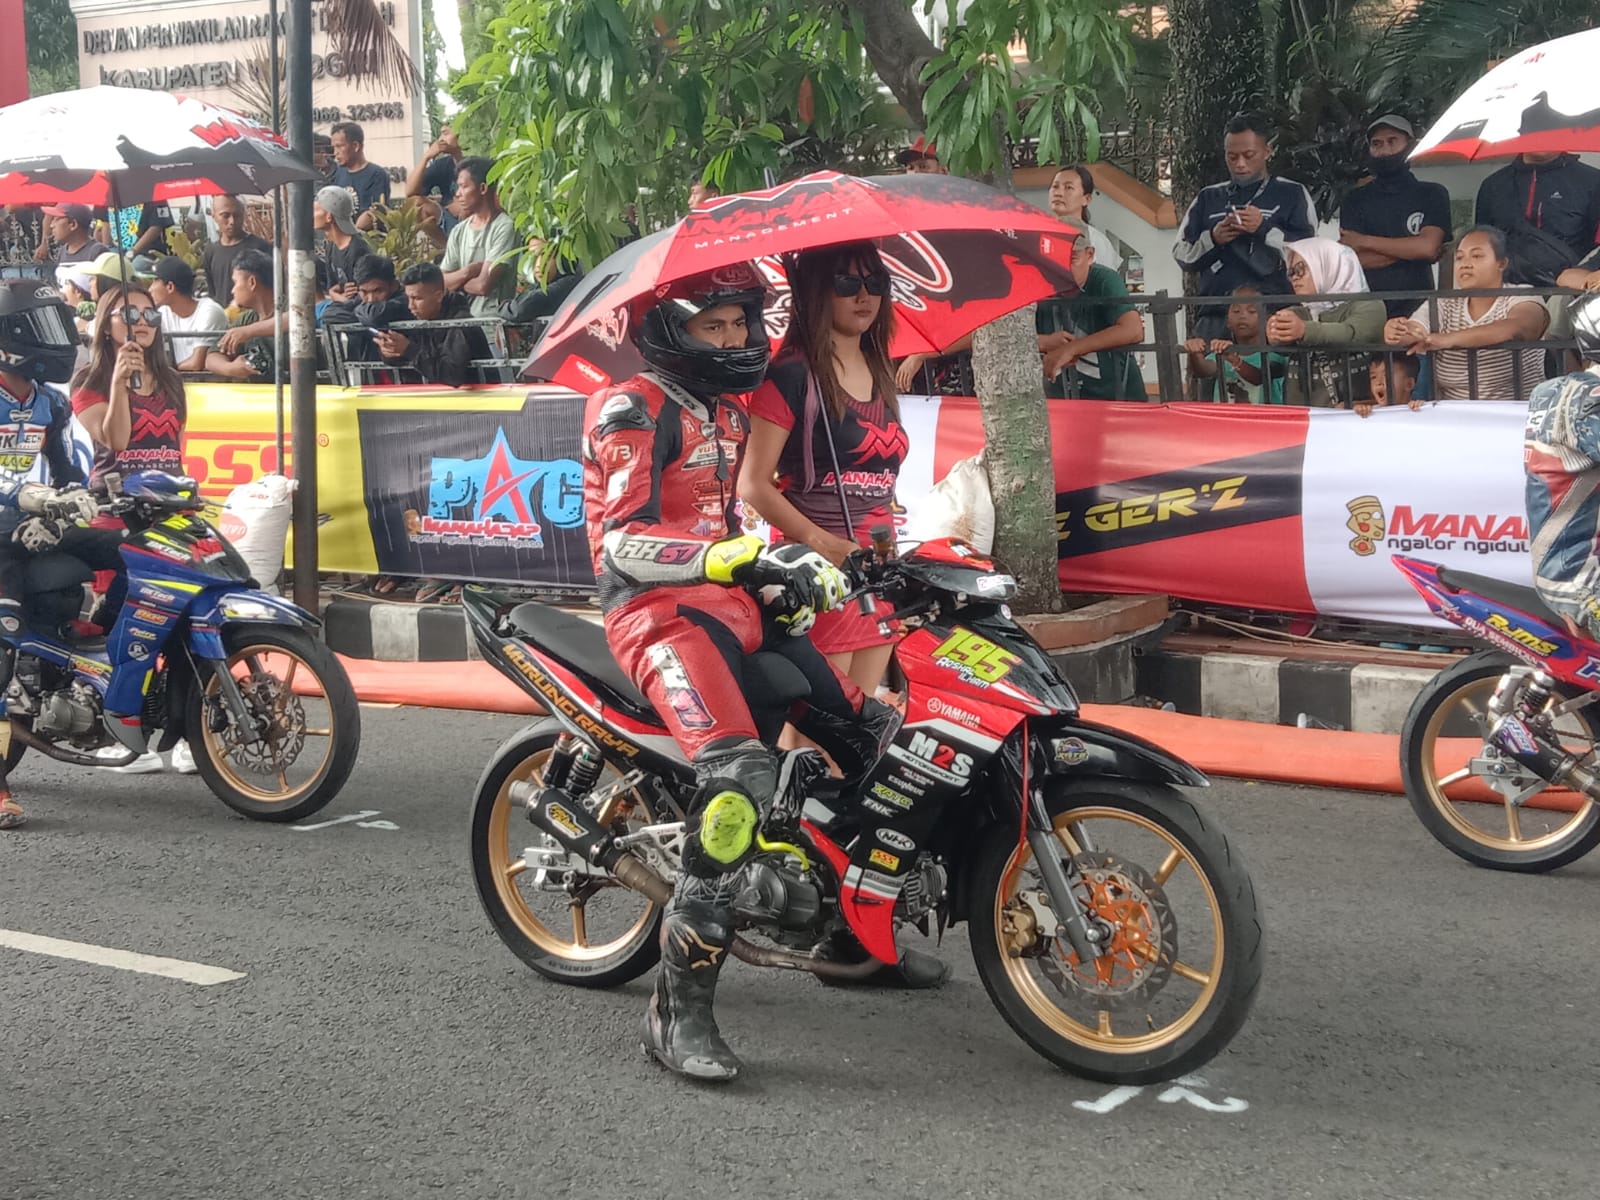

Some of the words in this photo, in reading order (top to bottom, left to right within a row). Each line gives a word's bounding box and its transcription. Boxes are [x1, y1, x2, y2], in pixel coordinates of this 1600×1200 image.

[141, 14, 248, 50] PERWAKILAN
[99, 58, 241, 91] KABUPATEN
[1084, 475, 1248, 532] GER'Z
[1388, 538, 1456, 552] ngalor
[1464, 539, 1529, 554] ngidul
[931, 625, 1023, 683] 195
[502, 643, 579, 717] MURUNG
[574, 713, 641, 758] RAYA
[940, 701, 981, 729] YAMAHA
[902, 753, 960, 783] MOTORSPORT
[908, 730, 974, 777] M2S
